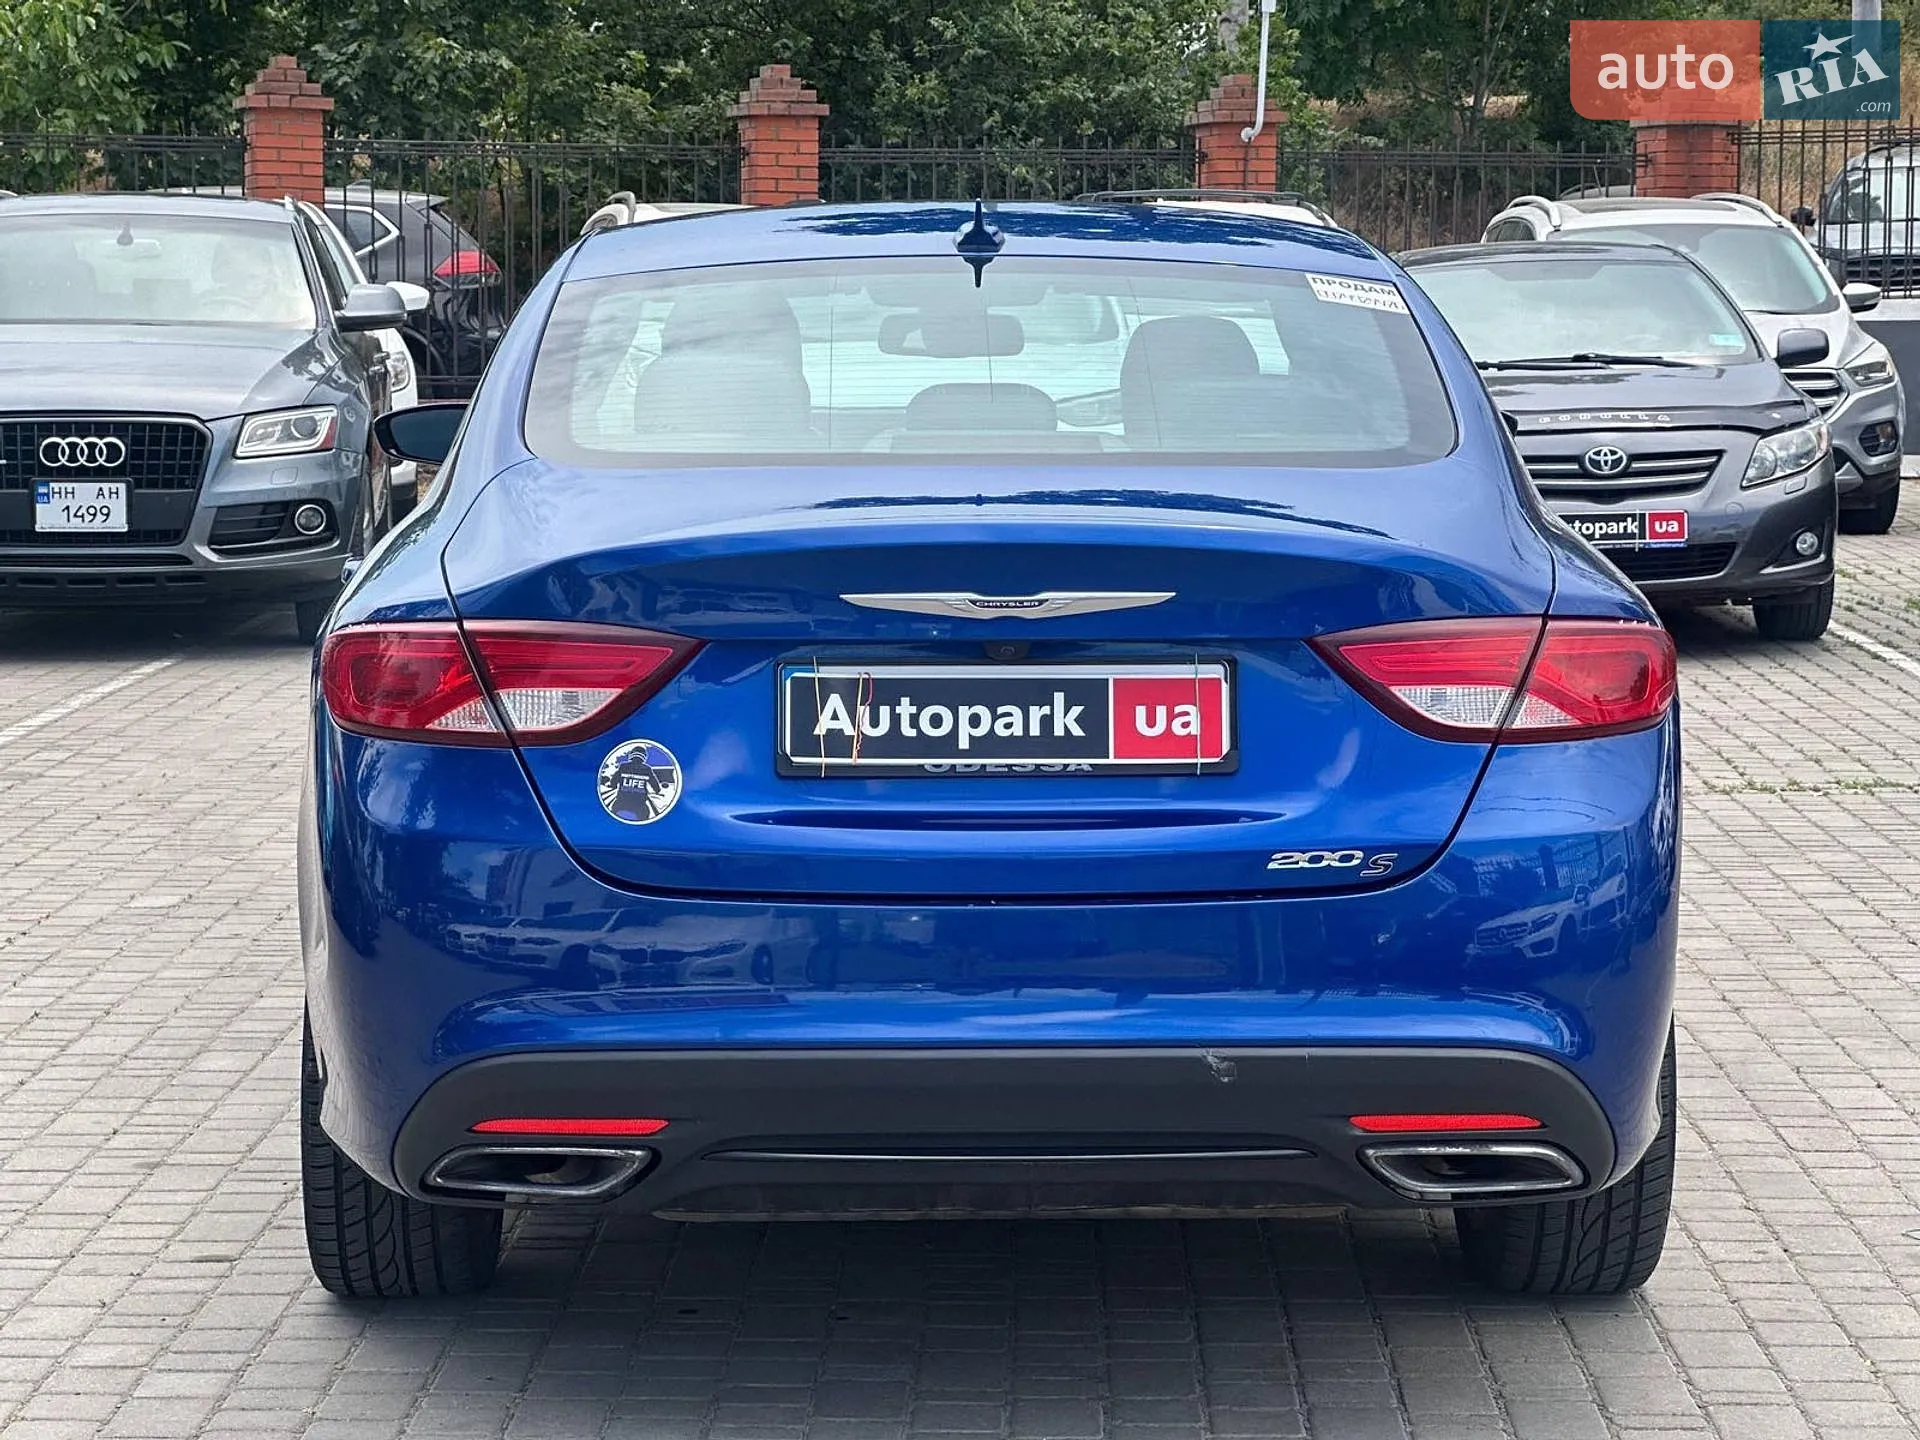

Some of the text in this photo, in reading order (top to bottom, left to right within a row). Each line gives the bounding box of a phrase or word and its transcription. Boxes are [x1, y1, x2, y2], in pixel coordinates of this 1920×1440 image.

[1311, 277, 1397, 297] ПРОДАМ
[51, 486, 119, 500] HH AH
[61, 504, 111, 524] 1499
[1568, 517, 1680, 539] topark ua
[813, 692, 1200, 749] Autopark ua
[623, 778, 645, 789] LIFE
[1267, 850, 1398, 877] 200 S
